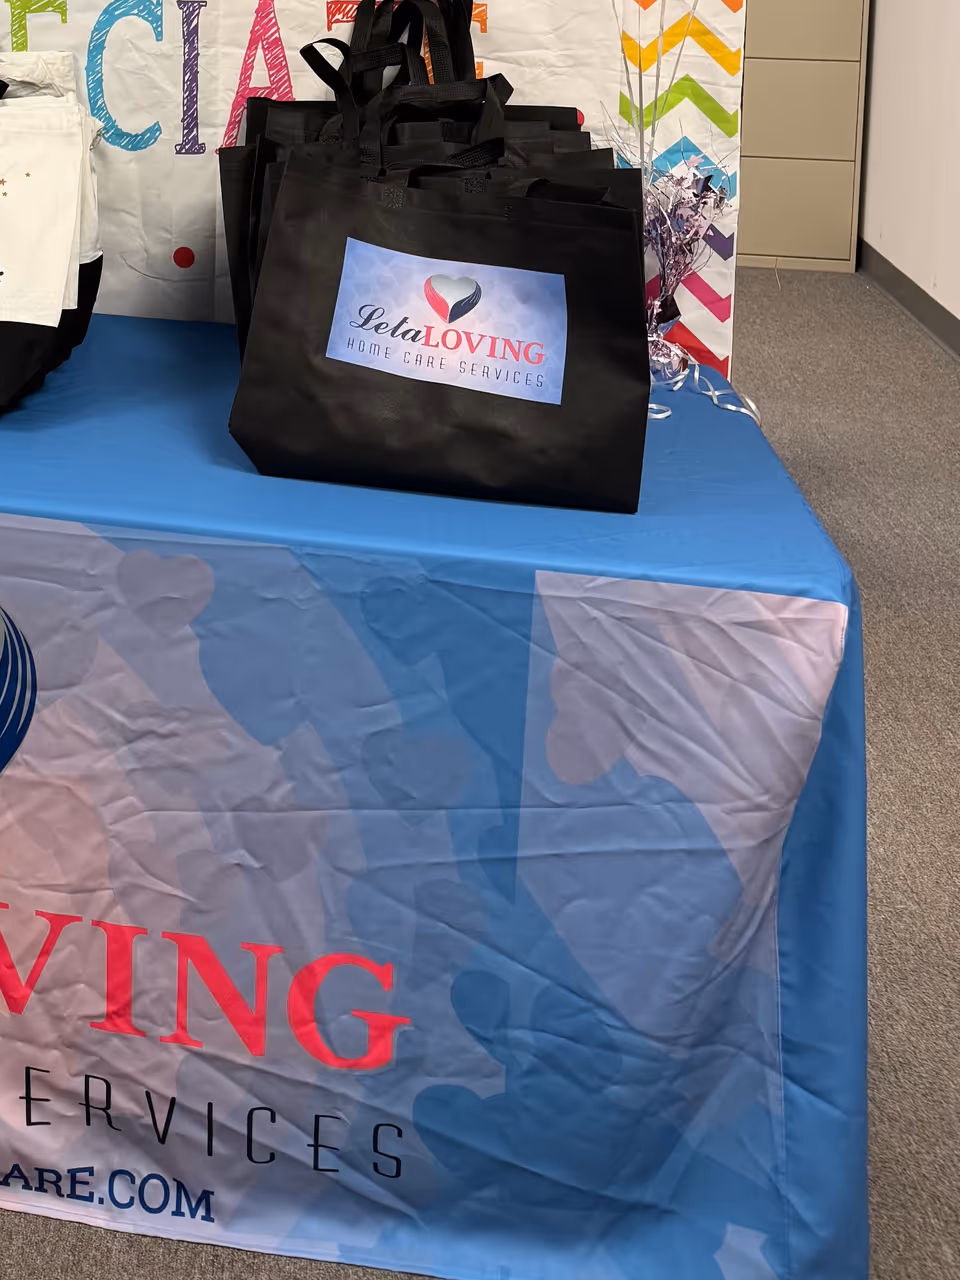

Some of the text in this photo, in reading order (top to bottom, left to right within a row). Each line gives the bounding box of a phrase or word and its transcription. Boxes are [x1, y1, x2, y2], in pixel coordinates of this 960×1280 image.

[346, 337, 545, 388] HOME CARE SERVICES
